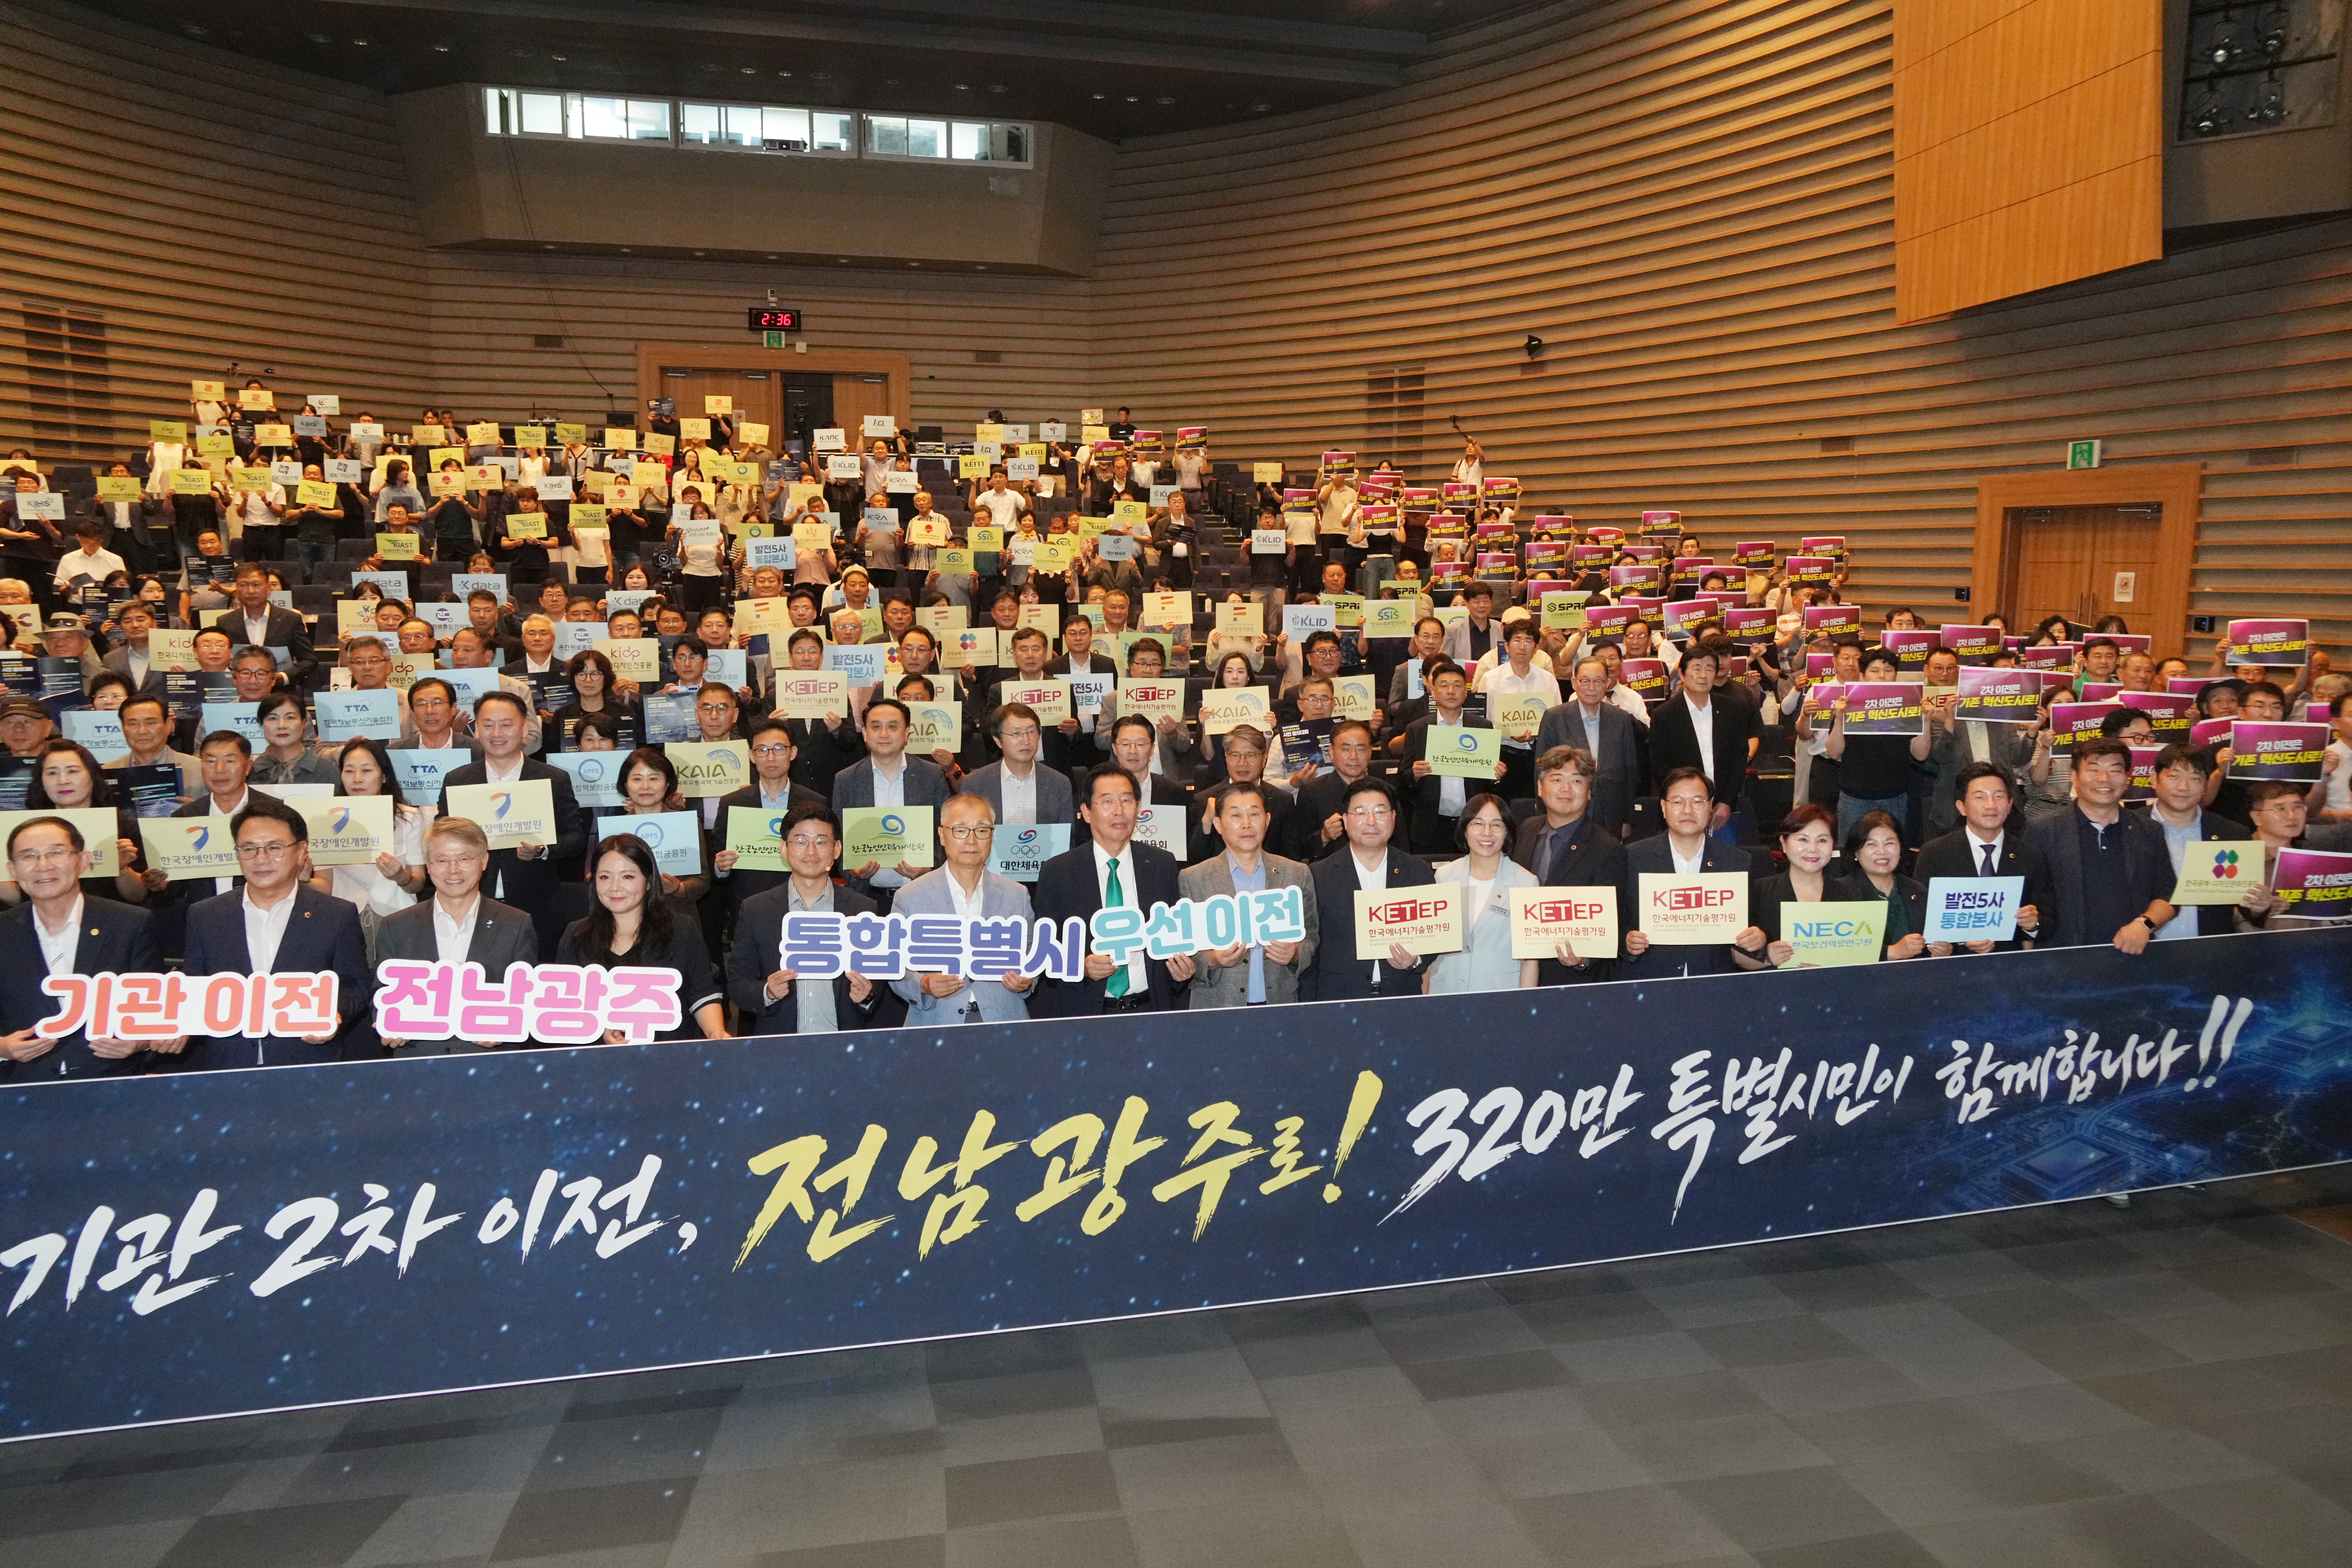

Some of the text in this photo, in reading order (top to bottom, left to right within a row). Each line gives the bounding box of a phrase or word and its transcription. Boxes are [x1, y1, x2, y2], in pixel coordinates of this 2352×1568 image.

[762, 313, 791, 326] 2:36
[755, 544, 786, 554] 발전5사
[756, 554, 788, 564] 통합본사
[472, 582, 500, 591] data
[1301, 615, 1327, 626] KLID
[1378, 609, 1399, 620] SSiS
[1741, 624, 1776, 636] 혁신도시로!
[1749, 619, 1766, 627] 이전은
[2248, 632, 2286, 643] 2차 이전은
[2231, 640, 2306, 654] 기존 혁신도시로!
[609, 647, 640, 663] kidp
[833, 654, 873, 665] 발전5사
[785, 679, 838, 695] KETEP
[1126, 687, 1176, 701] KETEP
[1980, 683, 2020, 695] 2차 이전은
[1010, 689, 1061, 705] KETEP
[1864, 696, 1903, 709] 2차 이전은
[1960, 694, 2039, 708] 기존 혁신도시로!
[1211, 706, 1251, 719] KAIA
[1503, 710, 1537, 722] KAIA
[1847, 705, 1922, 722] 기존 혁신도시로!
[324, 717, 392, 725] 한국정보통신기술협회
[2256, 738, 2303, 752] 2차 이전은
[1432, 755, 1492, 765] 한국노인인력개발원
[2233, 750, 2324, 766] 기존 혁신도시로!
[675, 764, 726, 779] KAIA
[851, 843, 925, 853] 한국노인인력개발원
[1001, 861, 1046, 870] 대한체육
[1653, 887, 1734, 910] KETEP
[1945, 892, 2004, 909] 발전5사
[1369, 899, 1447, 924] KETEP
[1524, 900, 1603, 923] KETEP
[1653, 913, 1736, 923] 한국에너지기술평가원
[1095, 890, 1302, 961] 우선 이전
[1940, 911, 2003, 929] 통합본사
[1369, 923, 1449, 937] 한국에너지기술평가원
[1524, 927, 1605, 936] 한국에너지기술평가원
[1793, 921, 1873, 937] NECA
[784, 917, 1081, 977] 통합특별시
[1790, 938, 1873, 952] 한국보건의료연구원
[42, 975, 333, 1035] 기관 이전
[381, 965, 676, 1039] 전남광주
[249, 1181, 466, 1299] 2차
[478, 1153, 697, 1266] 이전,
[731, 1070, 1383, 1273] 전남광주로!
[1377, 1064, 1646, 1226] 320만
[1651, 1043, 1914, 1226] 특별시민이
[1936, 995, 2254, 1124] 함께합니다!!
